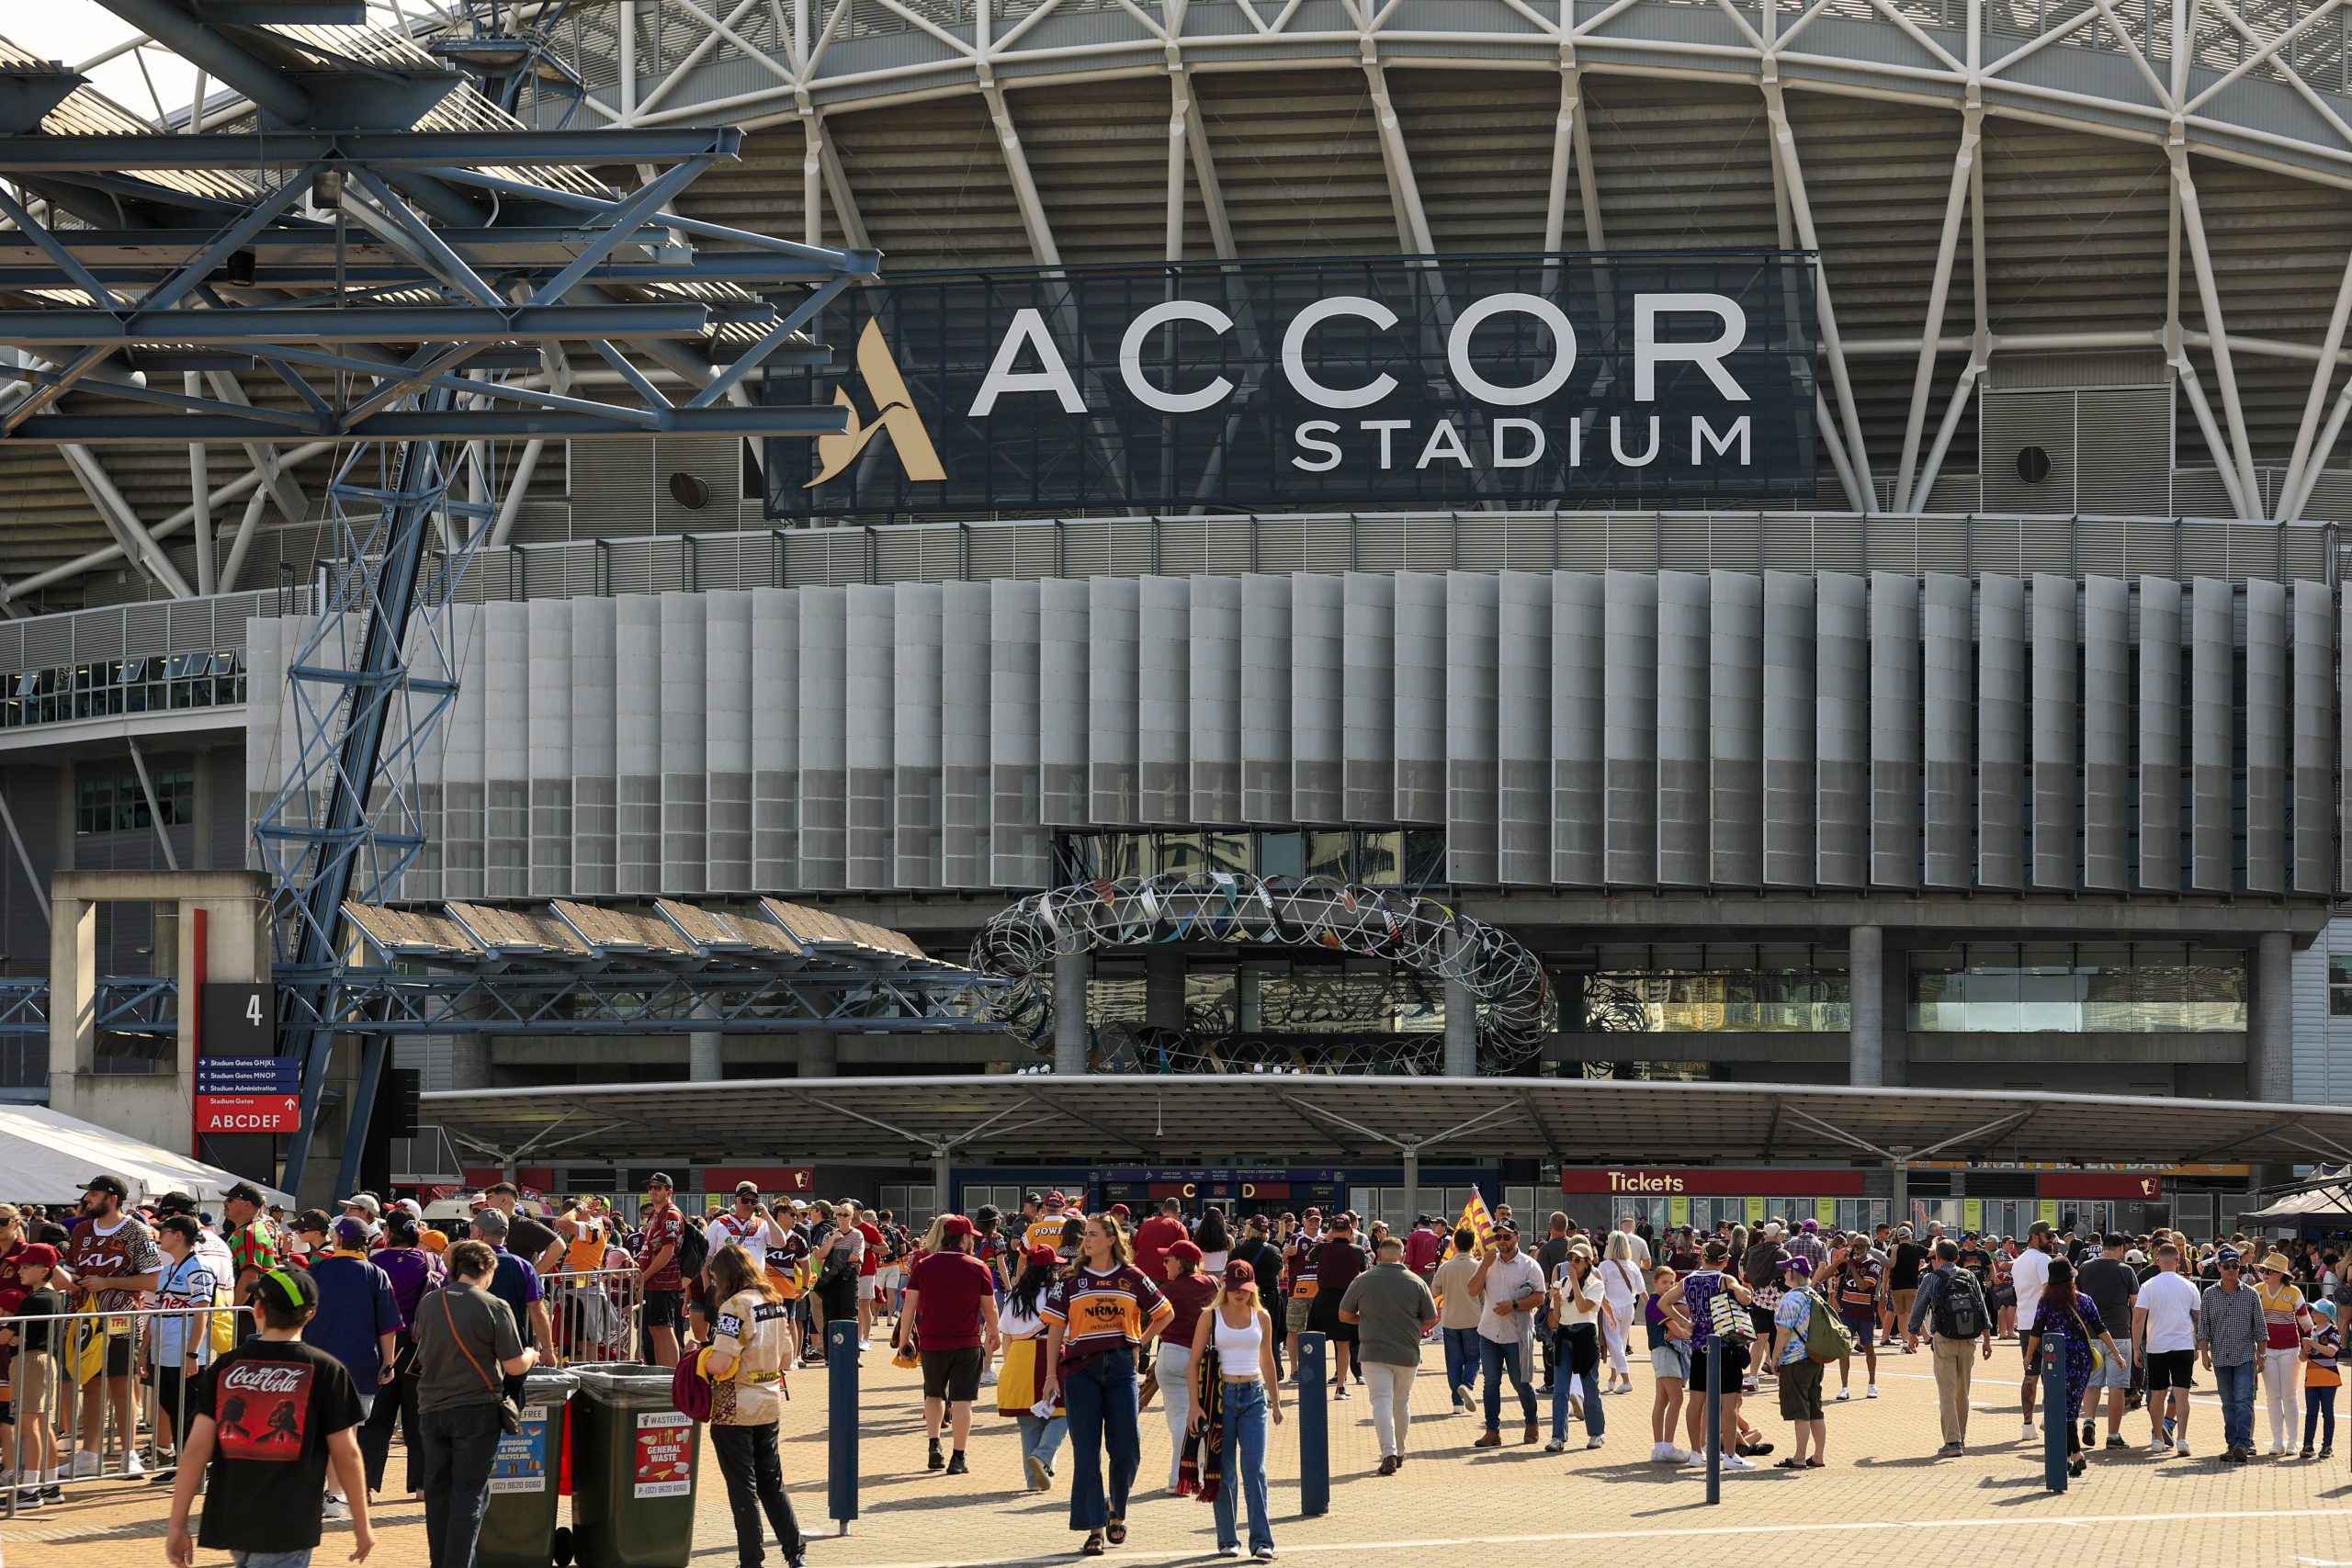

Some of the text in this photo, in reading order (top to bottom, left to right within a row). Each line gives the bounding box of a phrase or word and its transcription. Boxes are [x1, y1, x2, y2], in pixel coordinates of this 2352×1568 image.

[968, 291, 1750, 416] ACCOR
[1291, 415, 1750, 471] STADIUM
[246, 994, 263, 1026] 4
[210, 1115, 281, 1128] ABCDEF
[1608, 1172, 1684, 1192] Tickets
[1182, 1183, 1195, 1198] C
[1242, 1183, 1255, 1198] D
[1085, 1305, 1125, 1318] NRMA
[110, 1317, 128, 1327] TFH
[224, 1365, 306, 1393] Coca-Cola
[650, 1415, 689, 1424] WASTEFREE
[647, 1445, 681, 1454] GENERAL
[651, 1453, 677, 1463] WASTE
